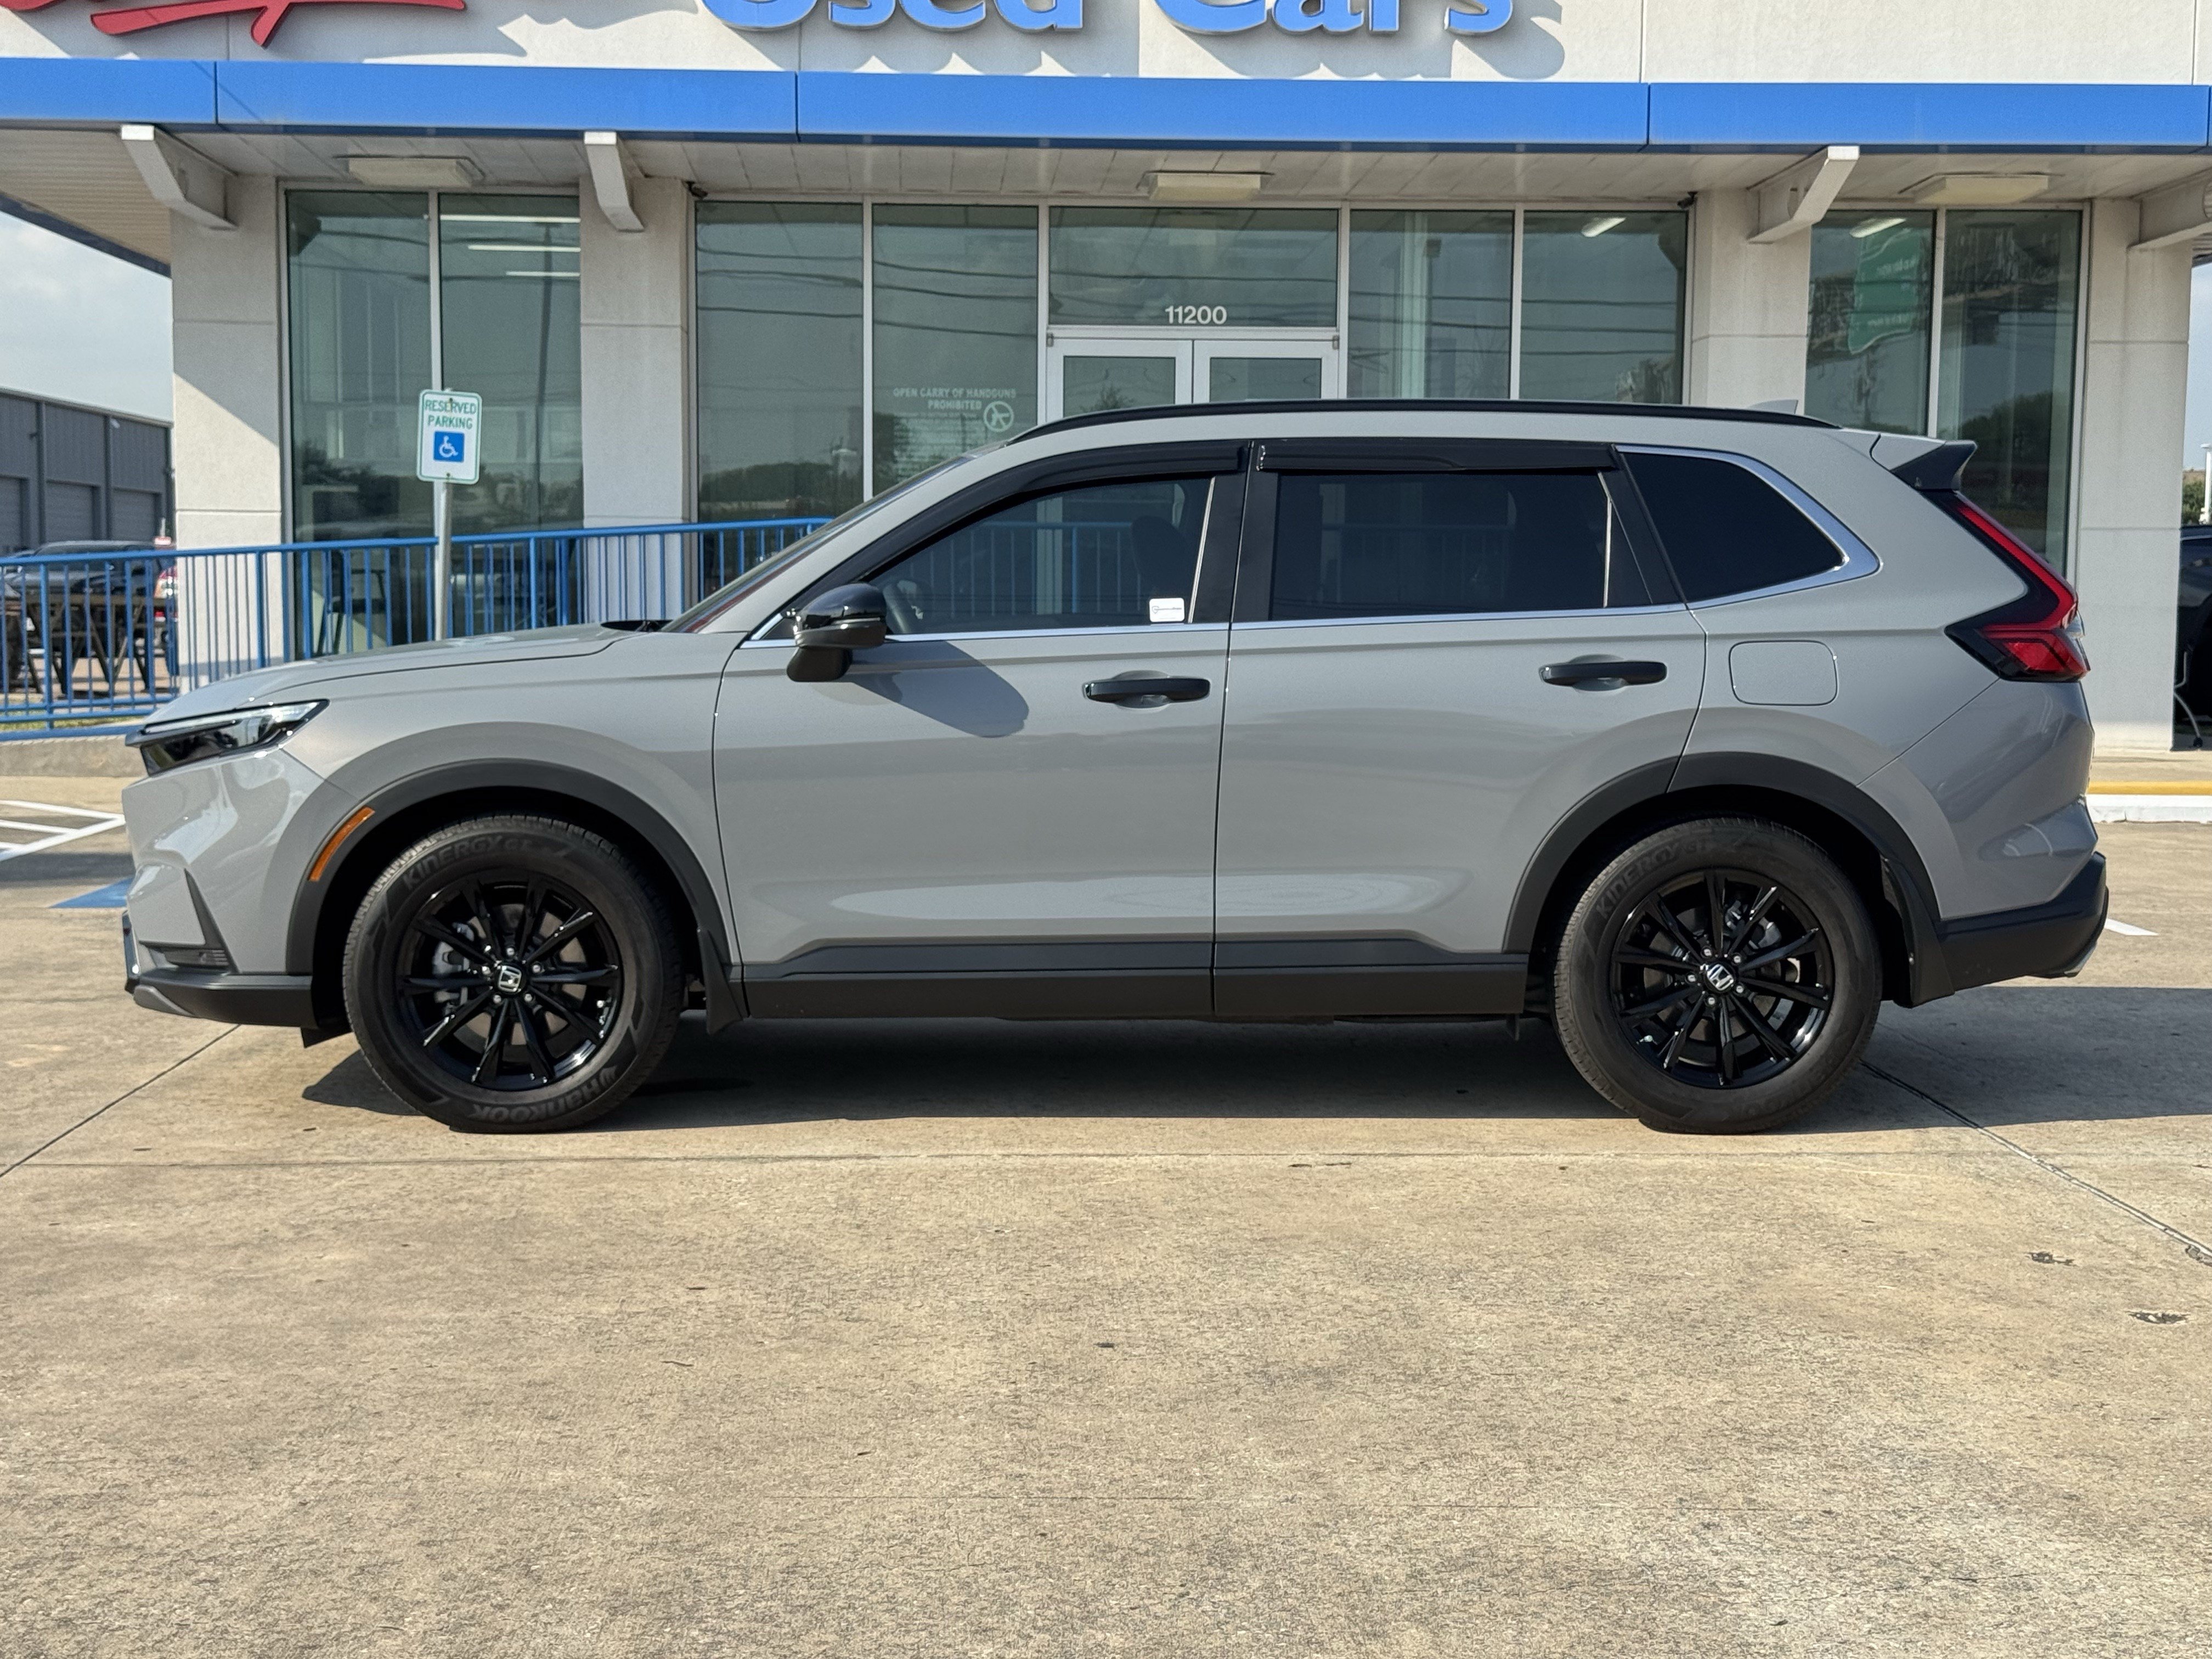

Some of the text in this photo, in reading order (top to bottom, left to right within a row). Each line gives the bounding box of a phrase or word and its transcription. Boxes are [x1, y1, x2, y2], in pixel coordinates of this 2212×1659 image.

[1165, 305, 1227, 325] 11200
[893, 387, 917, 397] OPEN
[919, 387, 950, 397] CARRY
[951, 388, 964, 397] OF
[425, 399, 477, 415] RESERVED
[928, 399, 983, 410] PROHIBITED
[427, 414, 473, 430] PARKING
